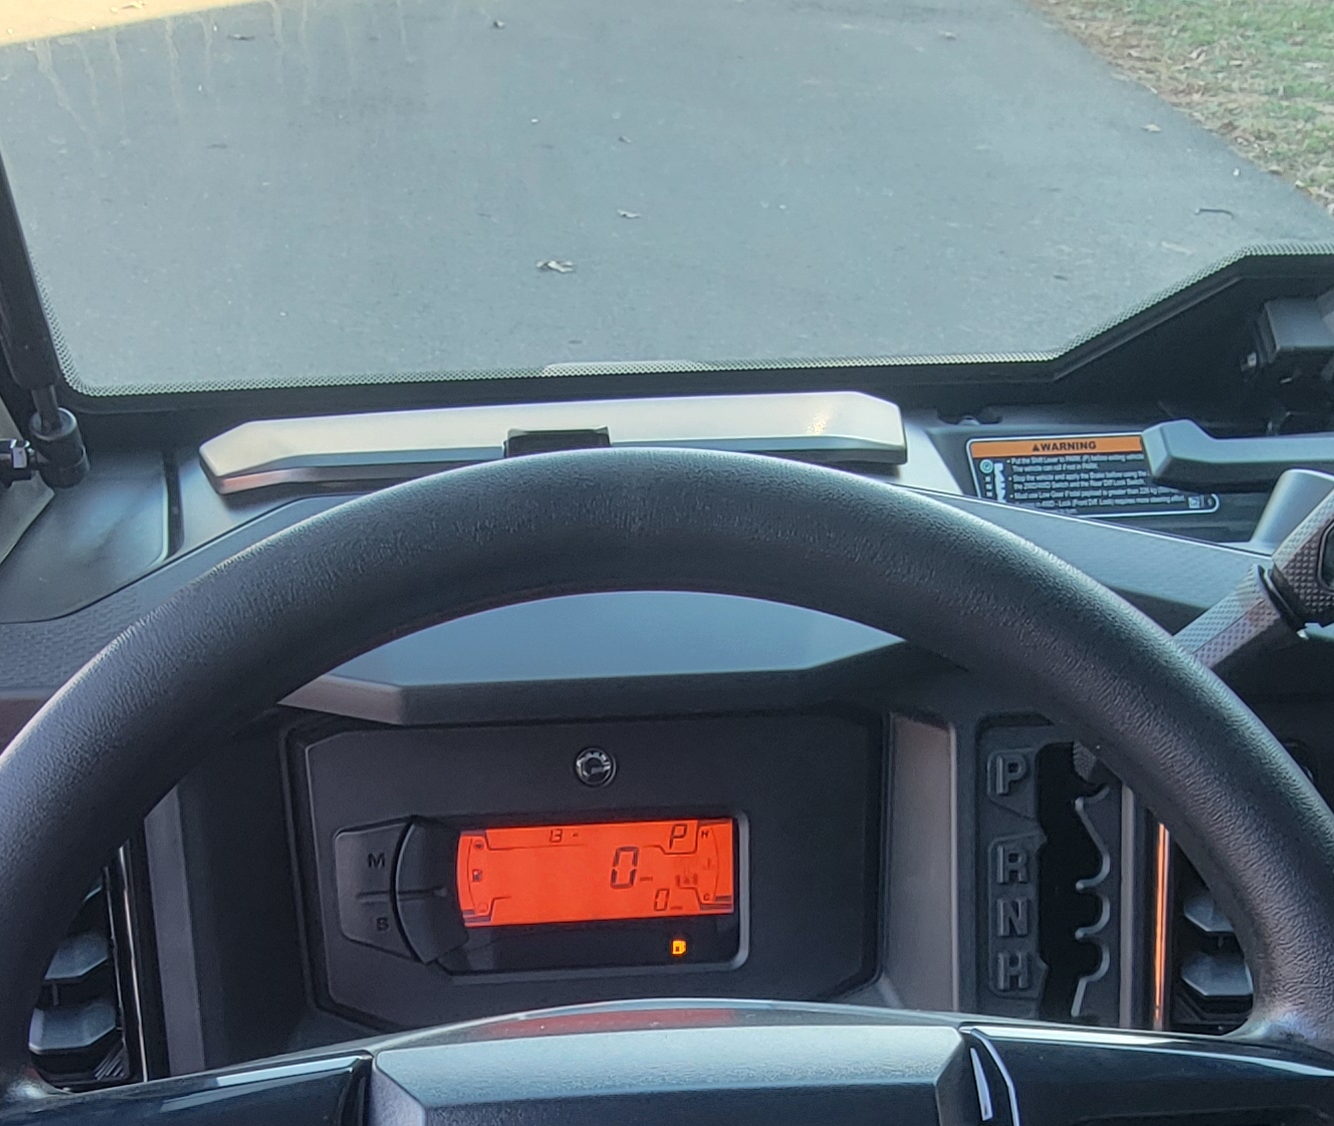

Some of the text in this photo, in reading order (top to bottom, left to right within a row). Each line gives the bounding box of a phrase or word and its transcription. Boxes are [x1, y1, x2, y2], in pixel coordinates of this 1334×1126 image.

[1041, 441, 1097, 451] WARNING
[995, 754, 1028, 796] P
[669, 823, 687, 849] P
[368, 852, 386, 868] M
[610, 846, 639, 889] 0
[997, 844, 1028, 885] R
[997, 898, 1028, 937] N
[997, 951, 1029, 991] H
